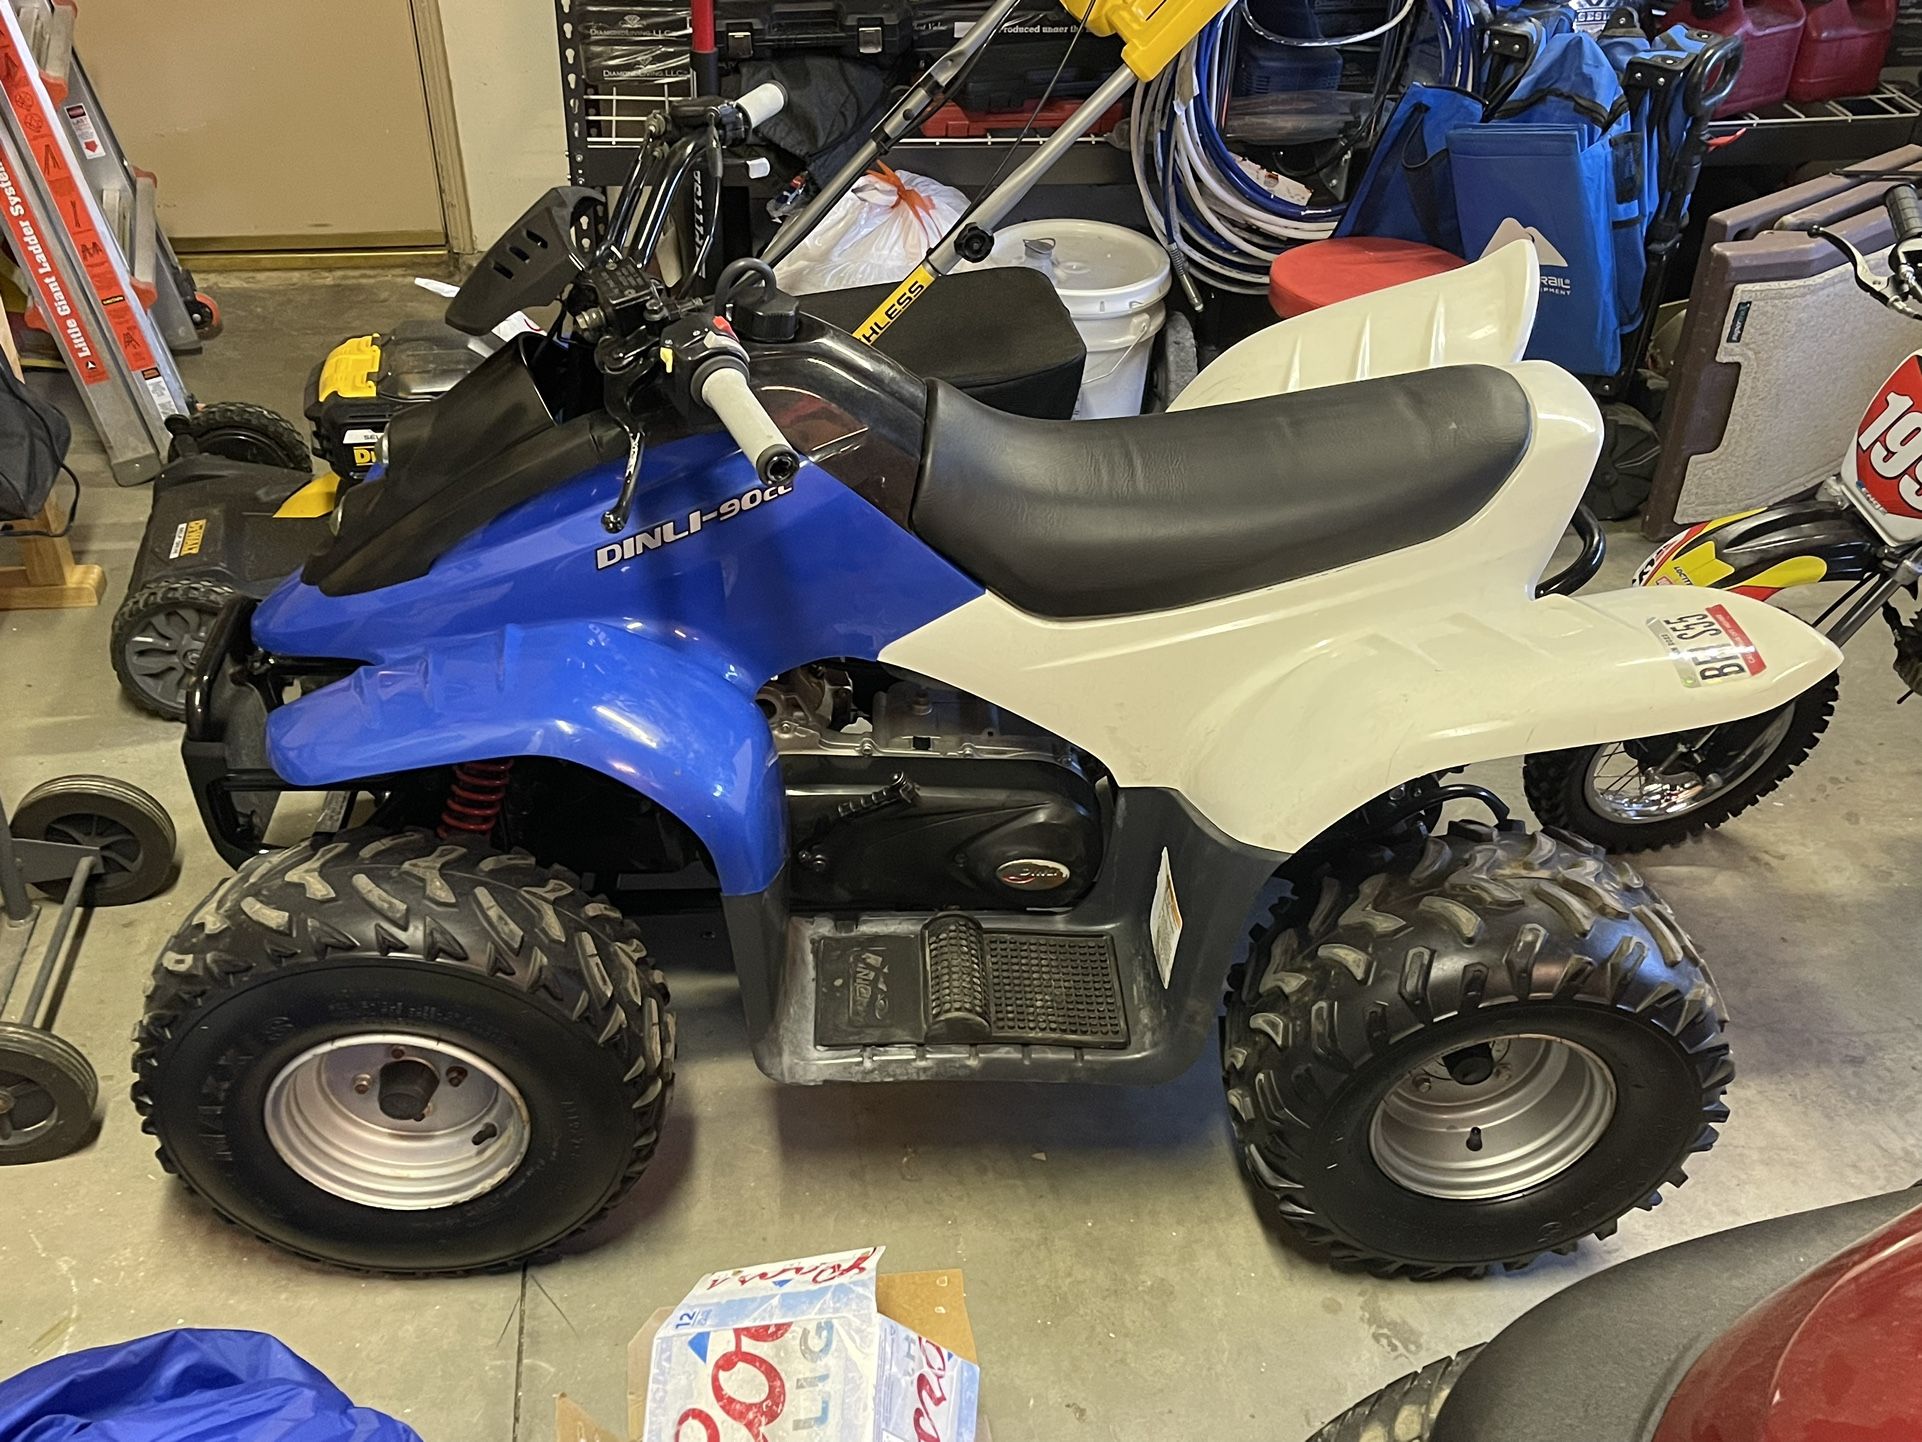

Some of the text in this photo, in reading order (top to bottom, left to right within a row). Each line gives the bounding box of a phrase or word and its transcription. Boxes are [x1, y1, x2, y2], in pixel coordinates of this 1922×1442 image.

[1000, 25, 1041, 33] roduced
[19, 218, 52, 280] Ladder
[44, 275, 71, 317] Giant
[67, 317, 92, 358] Little
[675, 1311, 696, 1329] 12
